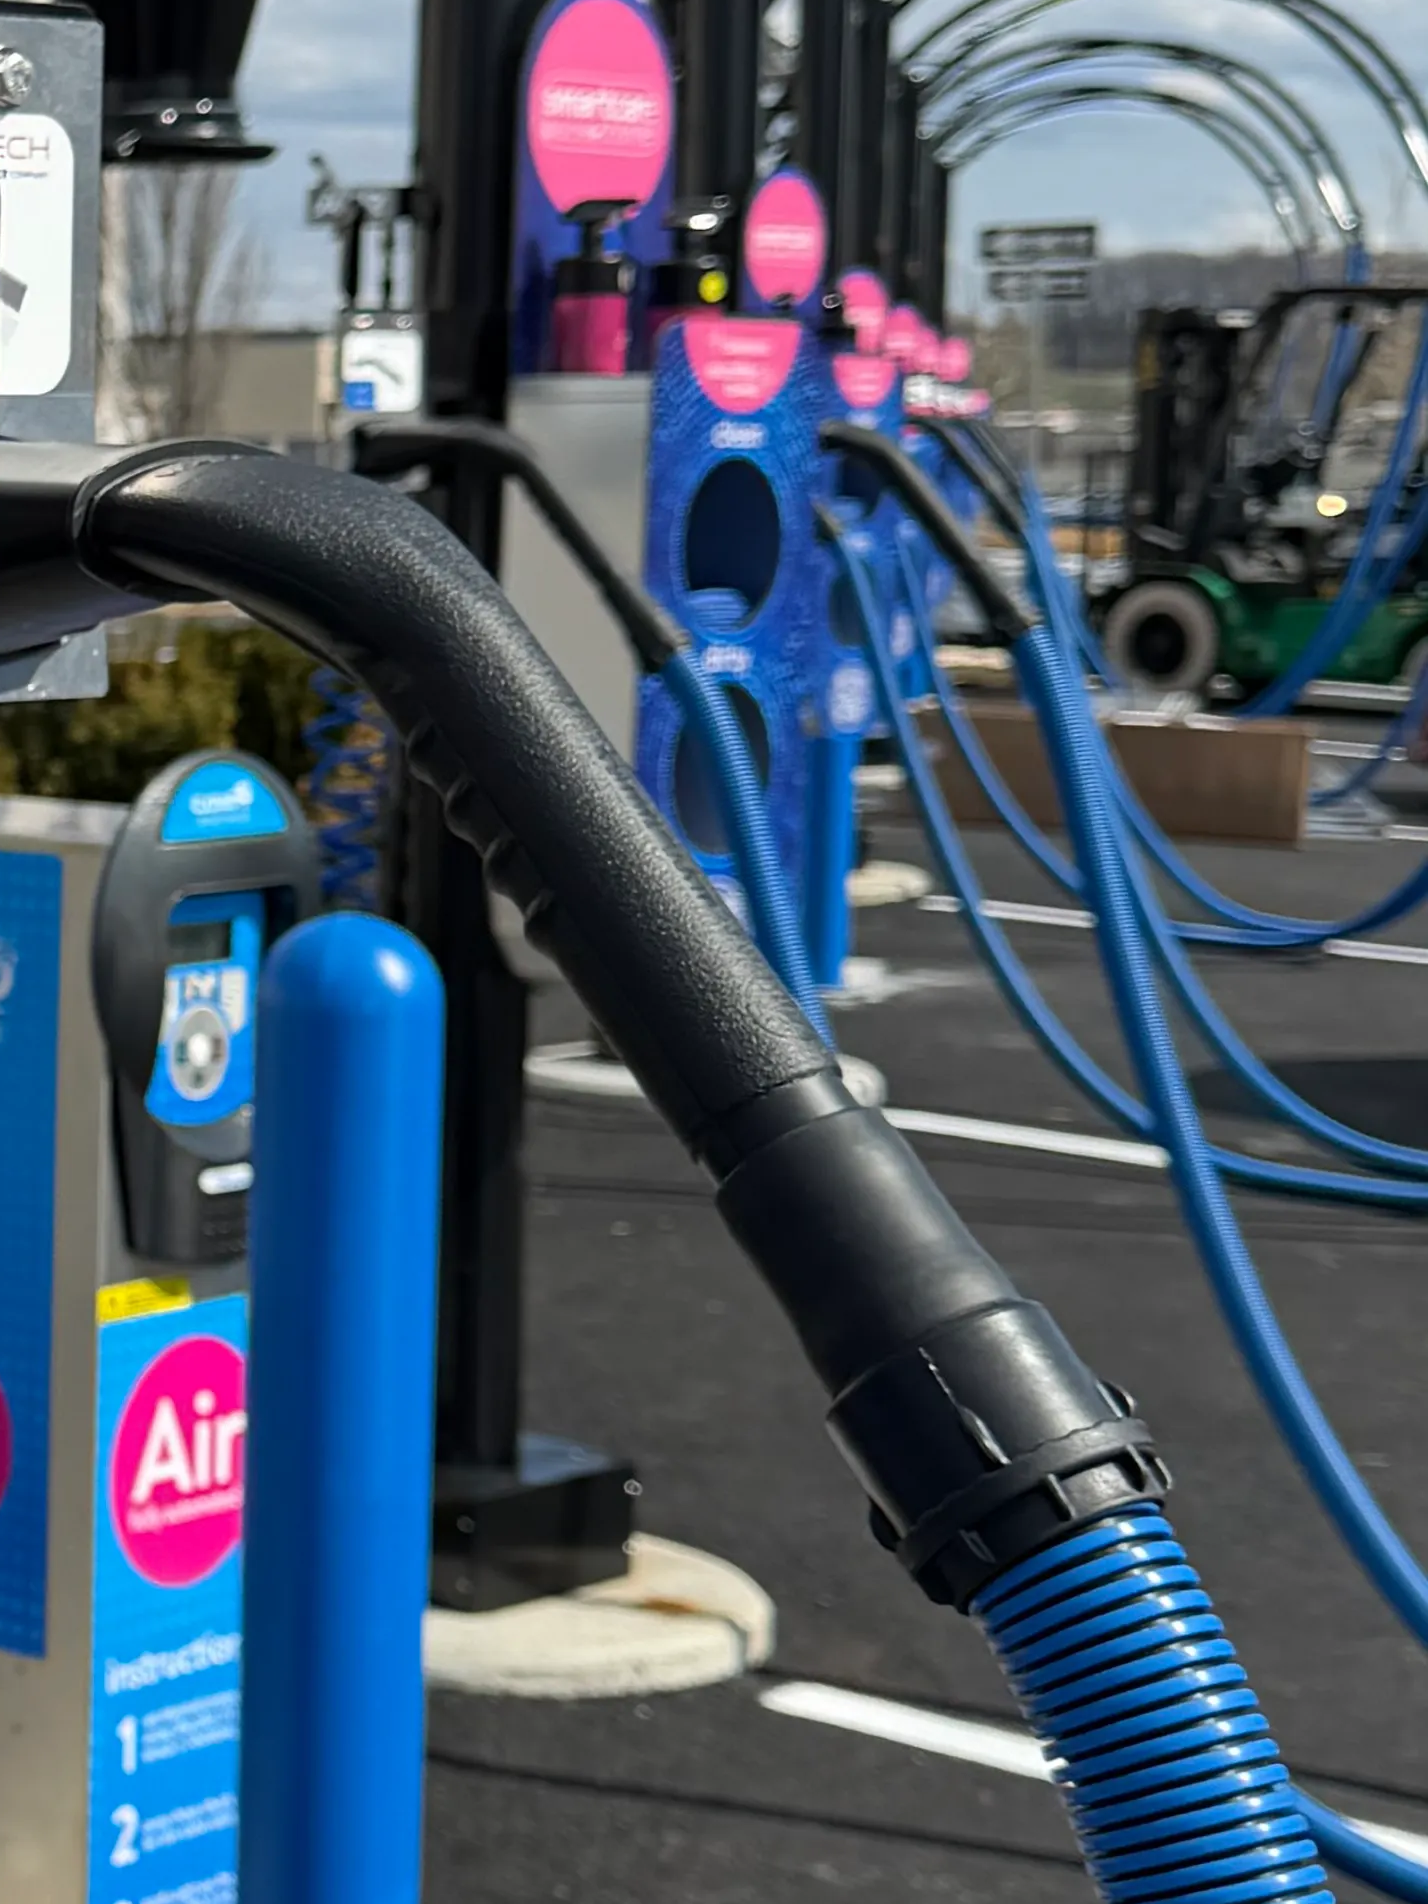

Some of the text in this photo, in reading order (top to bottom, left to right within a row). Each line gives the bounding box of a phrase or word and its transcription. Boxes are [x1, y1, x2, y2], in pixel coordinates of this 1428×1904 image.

[131, 1389, 248, 1504] Air
[116, 1714, 137, 1774] 1
[110, 1803, 139, 1867] 2
